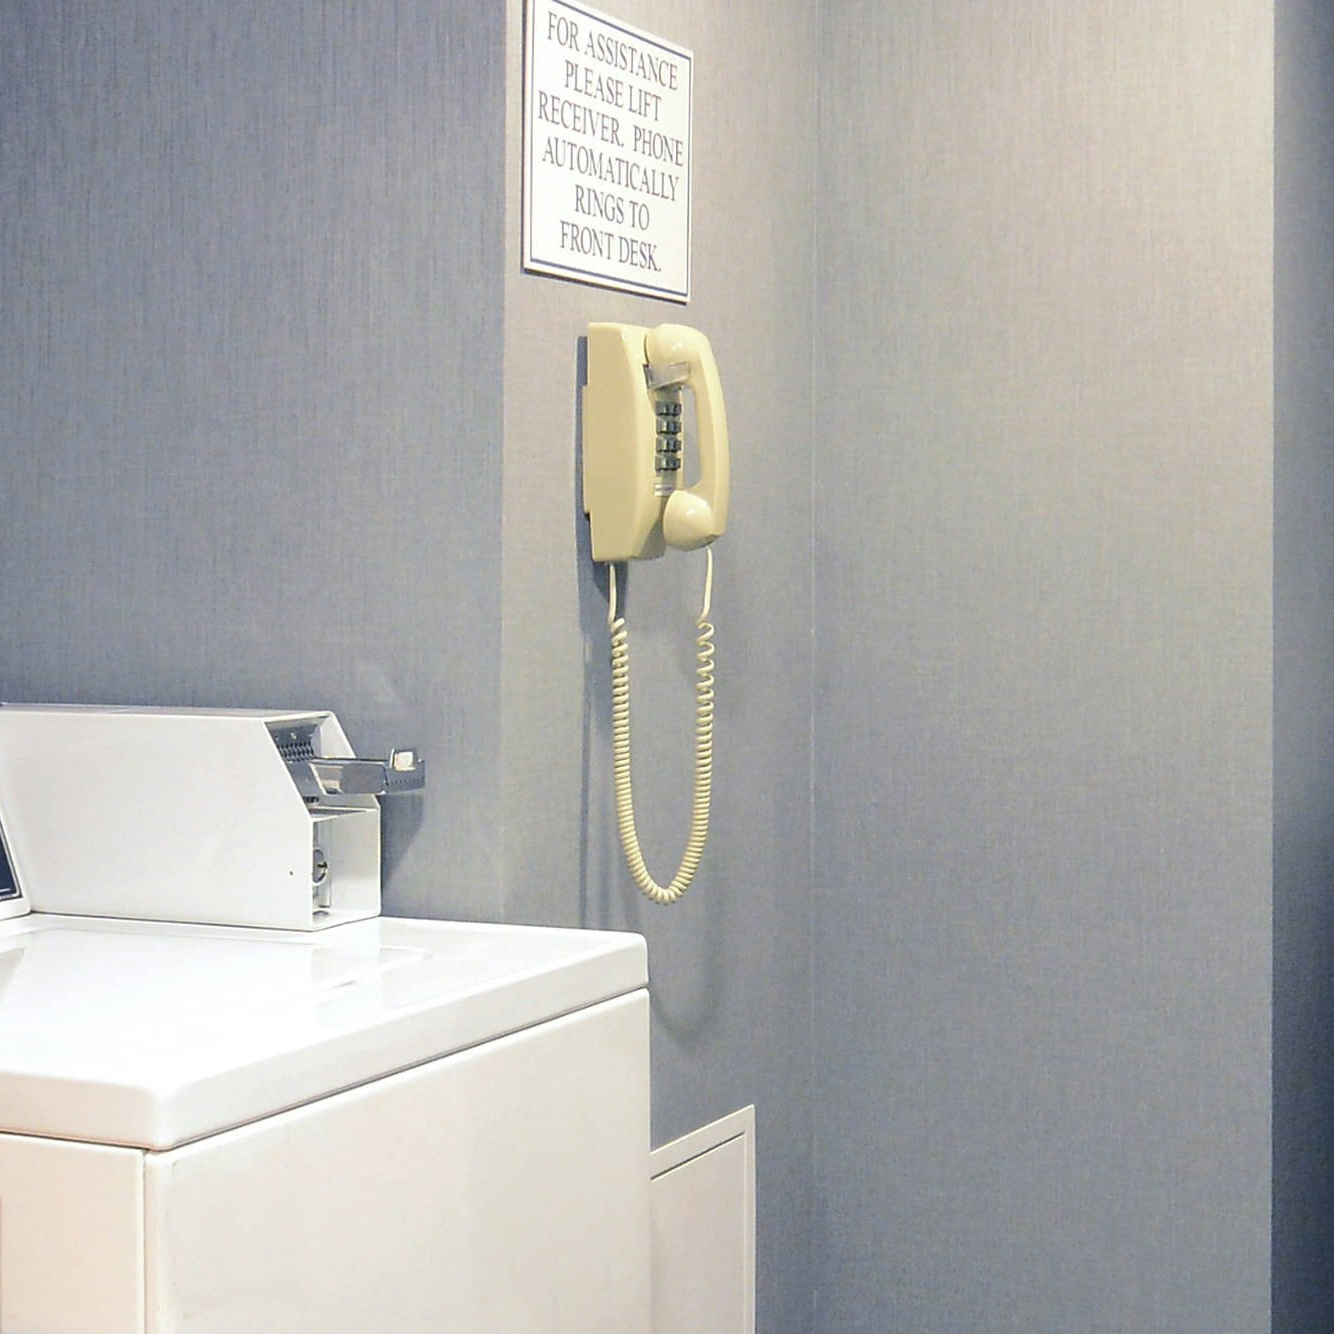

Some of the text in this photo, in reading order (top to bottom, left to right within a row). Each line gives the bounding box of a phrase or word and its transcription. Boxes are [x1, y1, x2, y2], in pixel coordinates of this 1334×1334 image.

[547, 11, 678, 91] FOR ASSISTANCE
[565, 59, 661, 122] PLEASE LIFT
[538, 90, 684, 167] RECEIVER. PHONE
[542, 136, 679, 202] AUTOMATICALLY
[575, 184, 650, 231] RINGS TO
[560, 220, 662, 272] FRONT DESK.
